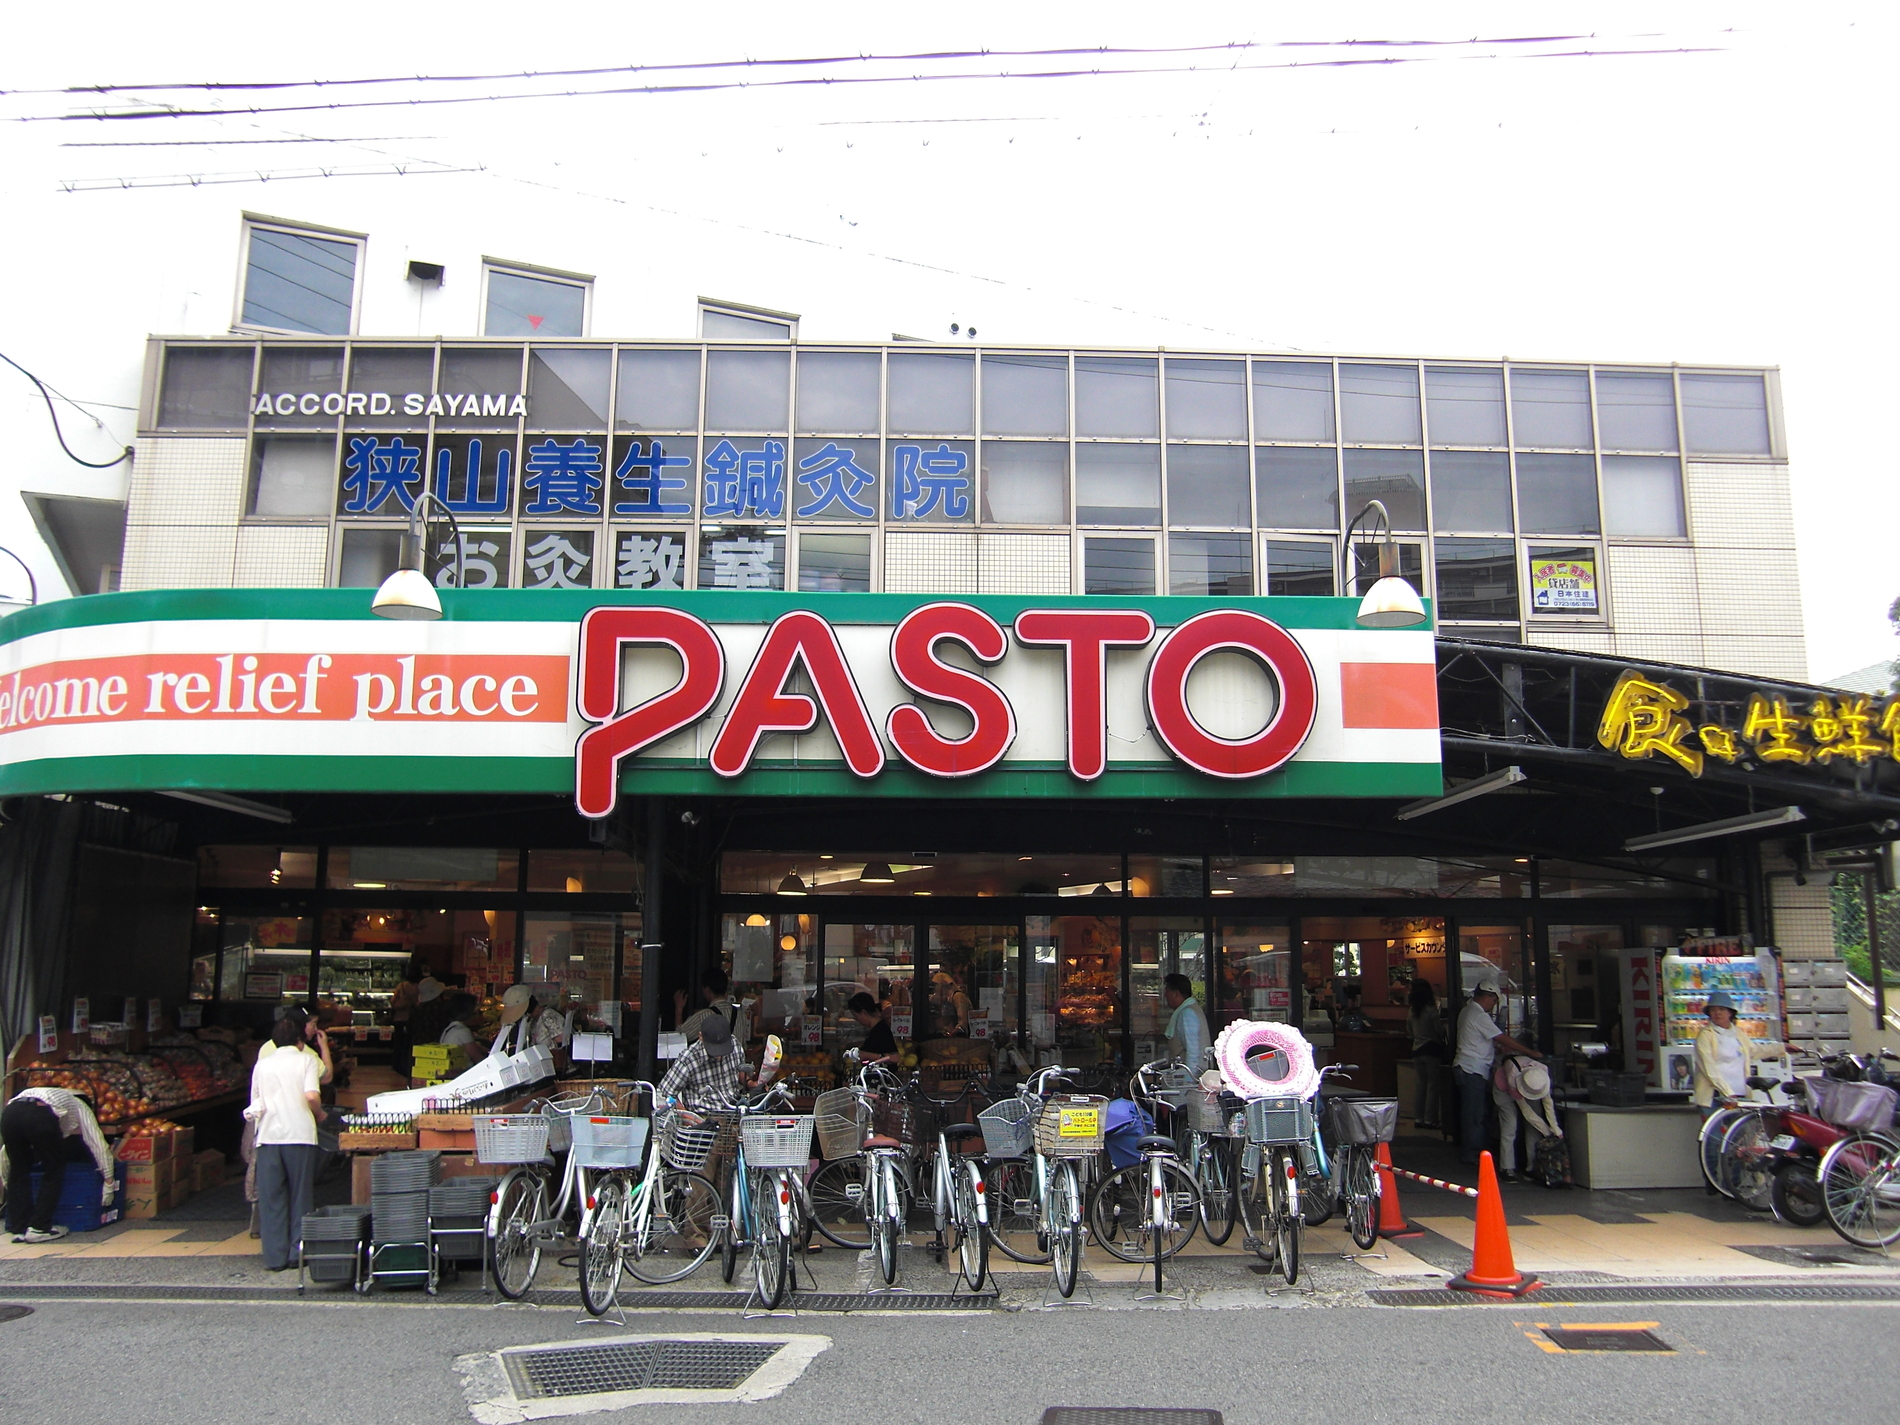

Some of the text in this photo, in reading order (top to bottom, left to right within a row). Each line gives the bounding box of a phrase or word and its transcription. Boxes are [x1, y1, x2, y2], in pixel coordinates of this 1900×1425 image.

[254, 393, 528, 417] ACCORD. SAYAMA
[343, 436, 969, 519] 狭山養生鍼灸院
[435, 534, 775, 590] お灸教室
[0, 653, 540, 729] elcome relief place
[574, 602, 1320, 821] PASTO
[1706, 956, 1731, 964] KIRIN
[550, 969, 588, 981] PASTO
[808, 1032, 820, 1042] 98
[896, 1025, 909, 1035] 98
[975, 1028, 986, 1037] 98
